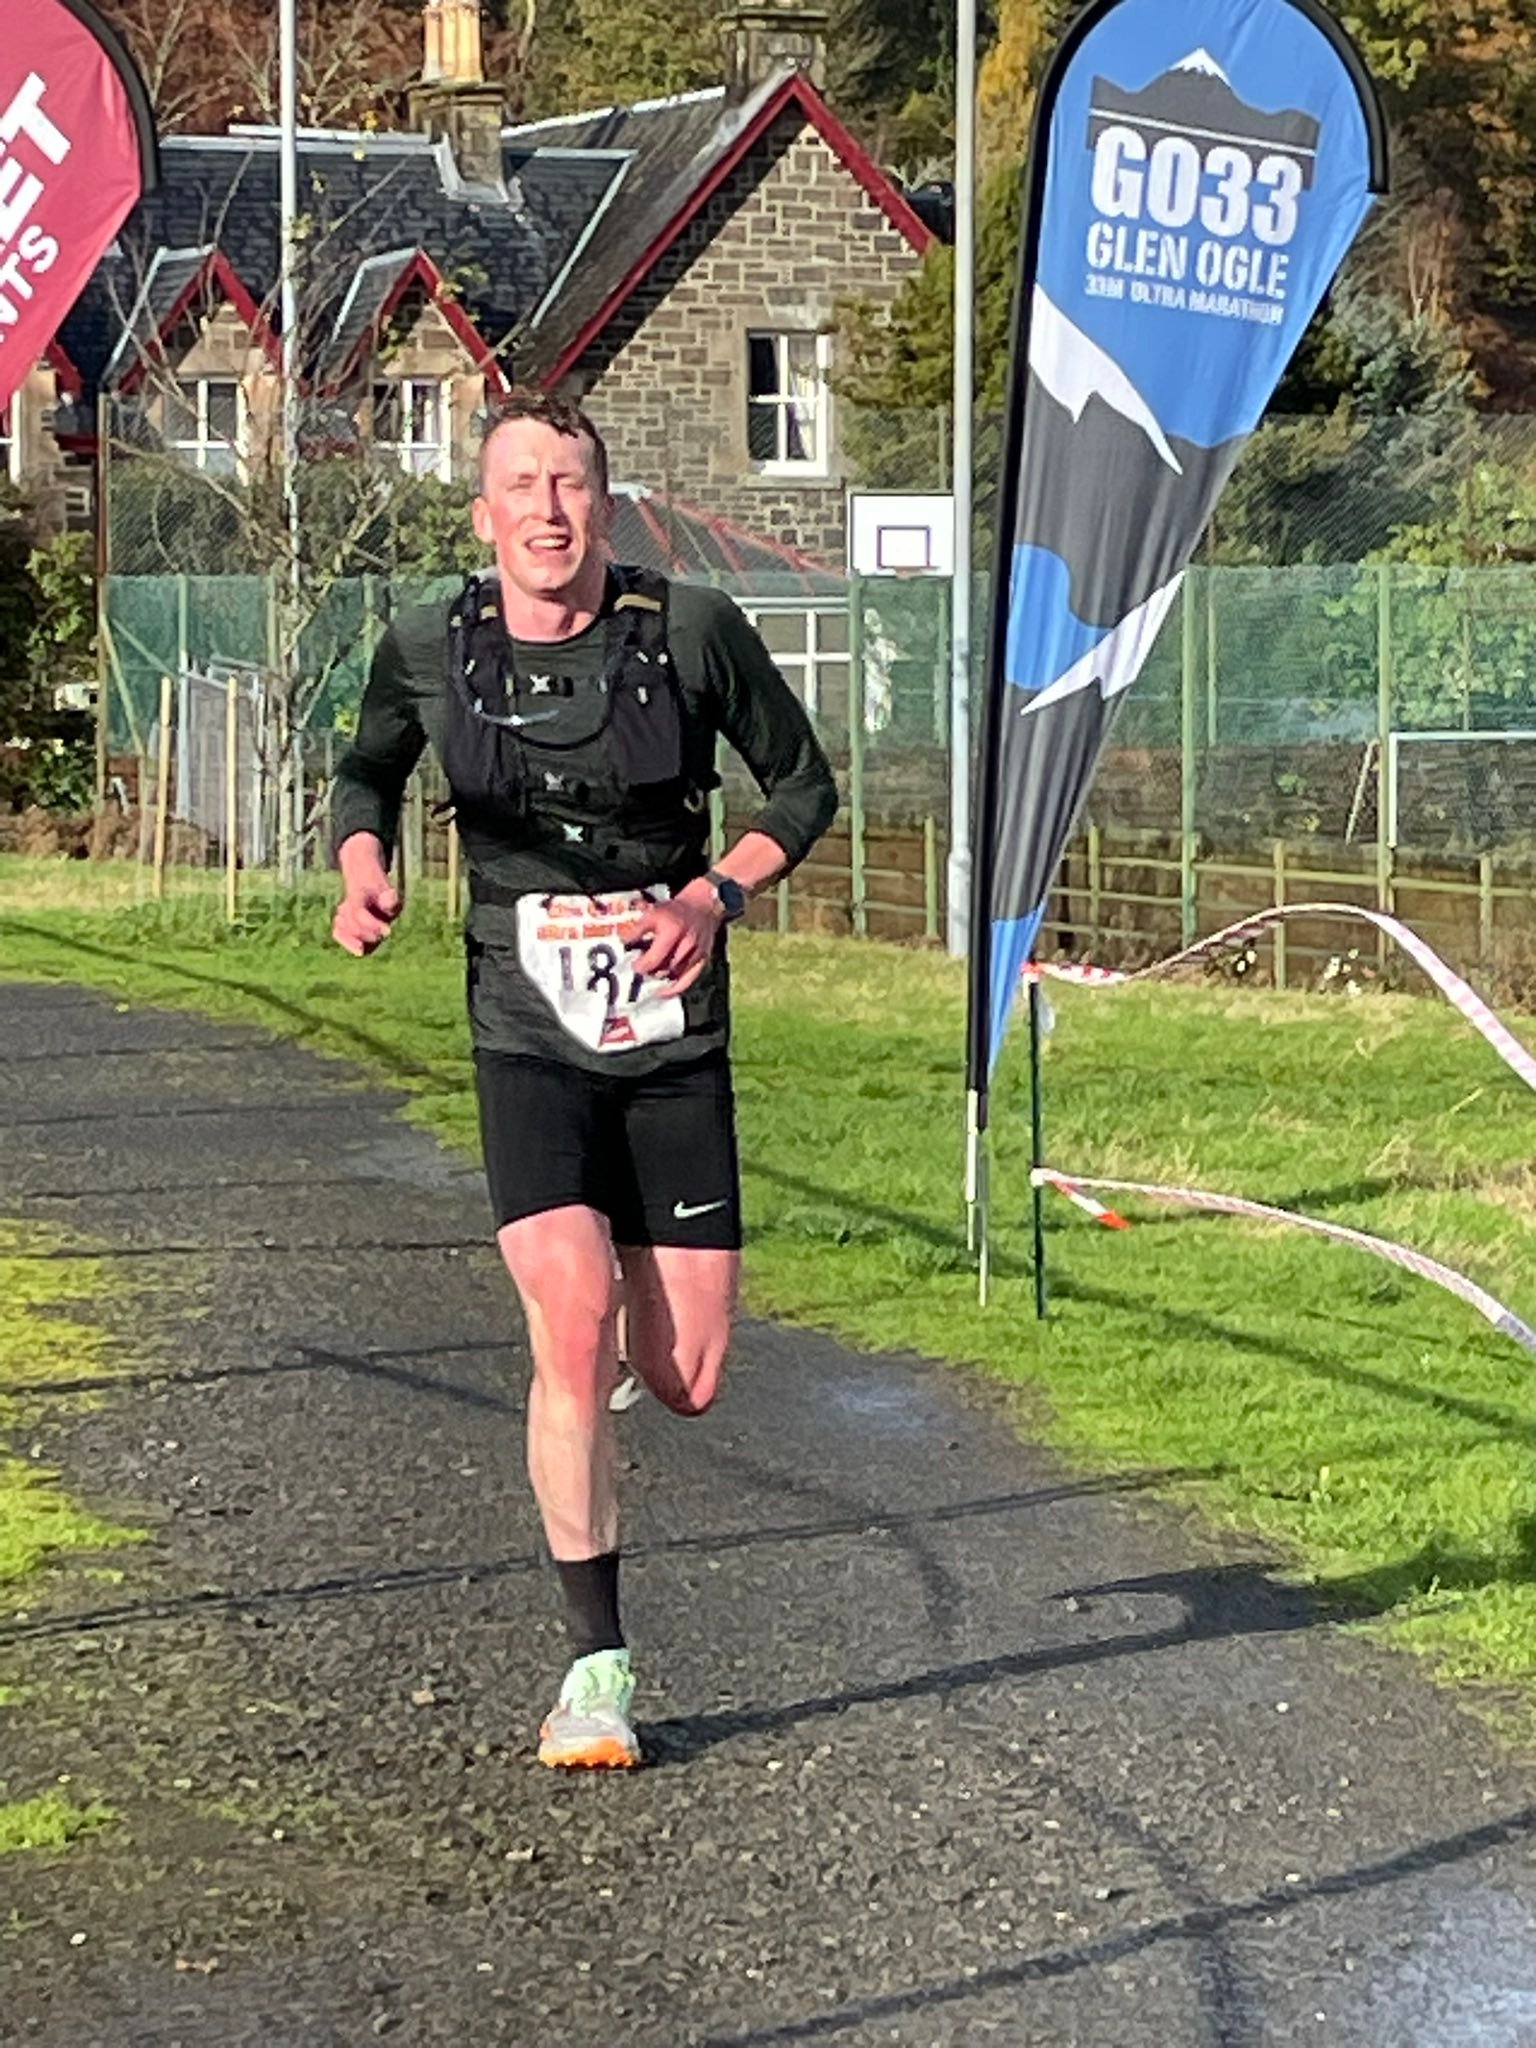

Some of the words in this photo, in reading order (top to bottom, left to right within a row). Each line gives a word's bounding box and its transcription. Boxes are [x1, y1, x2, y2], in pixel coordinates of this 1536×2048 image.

[1091, 125, 1302, 246] GO33
[1085, 221, 1188, 281] GLEN
[1195, 240, 1289, 300] OGLE
[1130, 280, 1186, 310] ULTRA
